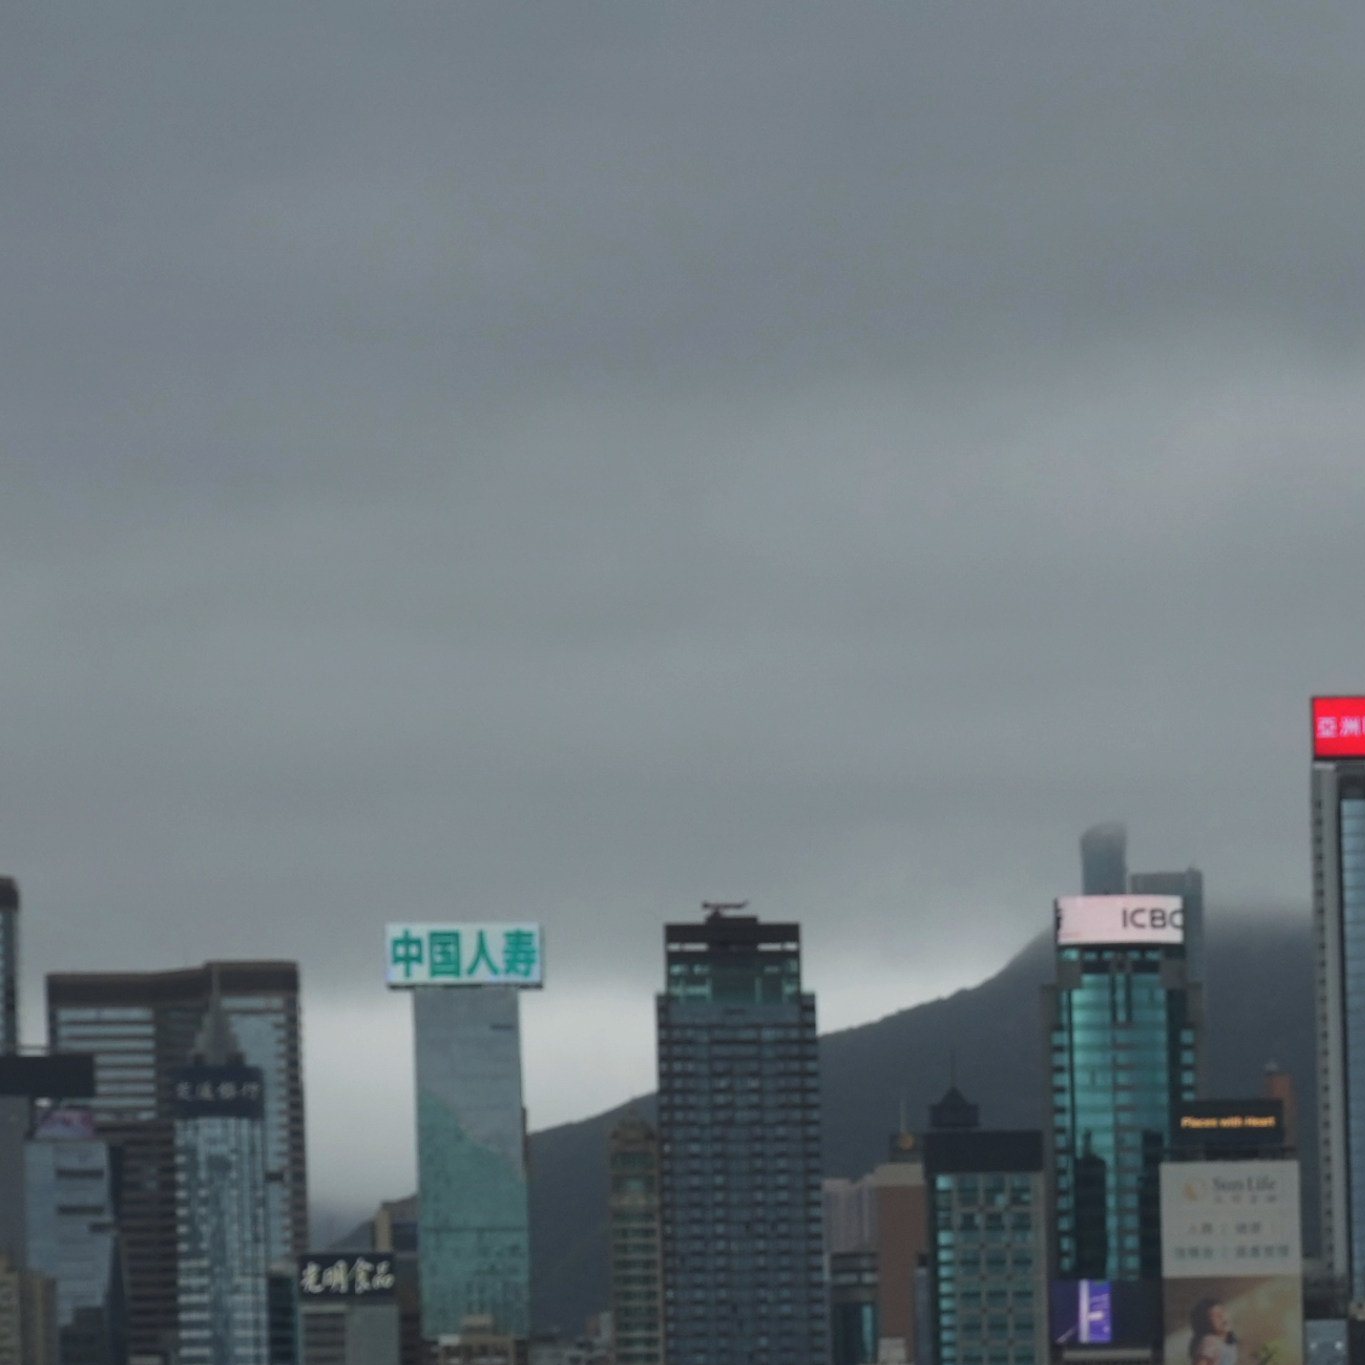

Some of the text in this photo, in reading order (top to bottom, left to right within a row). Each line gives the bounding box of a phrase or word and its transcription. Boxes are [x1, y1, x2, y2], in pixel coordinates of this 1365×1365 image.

[1121, 907, 1184, 930] ICBC
[391, 928, 538, 978] 中国人寿
[299, 1256, 396, 1295] 光明食品
